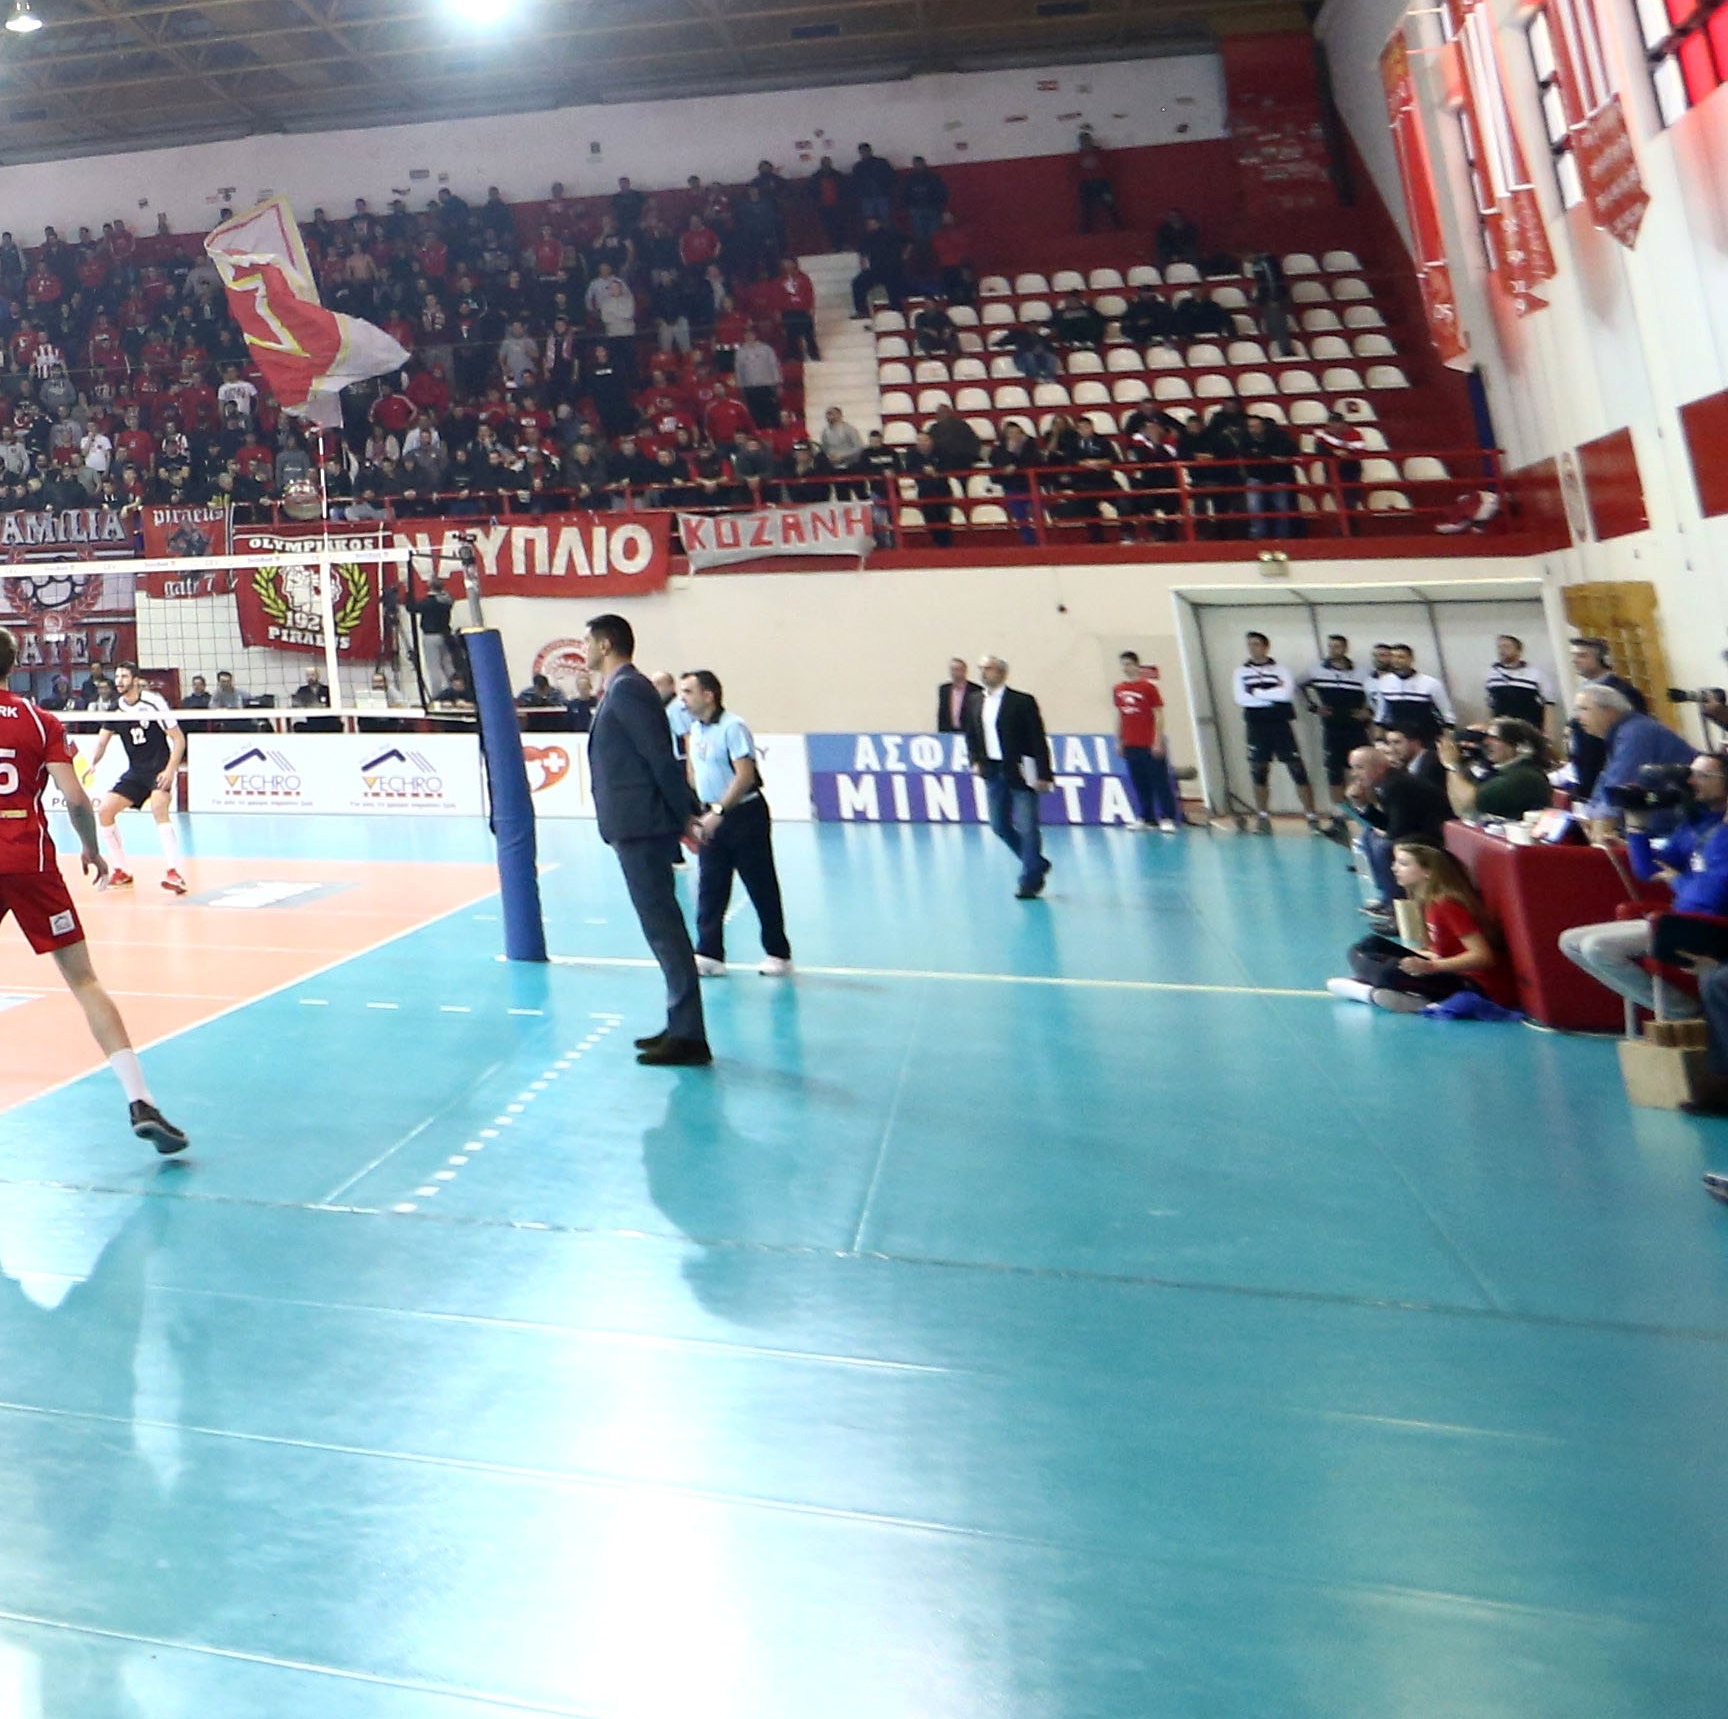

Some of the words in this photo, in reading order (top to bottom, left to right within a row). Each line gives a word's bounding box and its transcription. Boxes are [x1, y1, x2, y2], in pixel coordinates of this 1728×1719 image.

[684, 503, 872, 551] ΚΟΖΑΝΗ
[394, 524, 652, 581] ΝΑΥΠΛΙΟ
[285, 611, 323, 632] 192
[14, 631, 90, 666] ATE
[130, 727, 146, 745] 12
